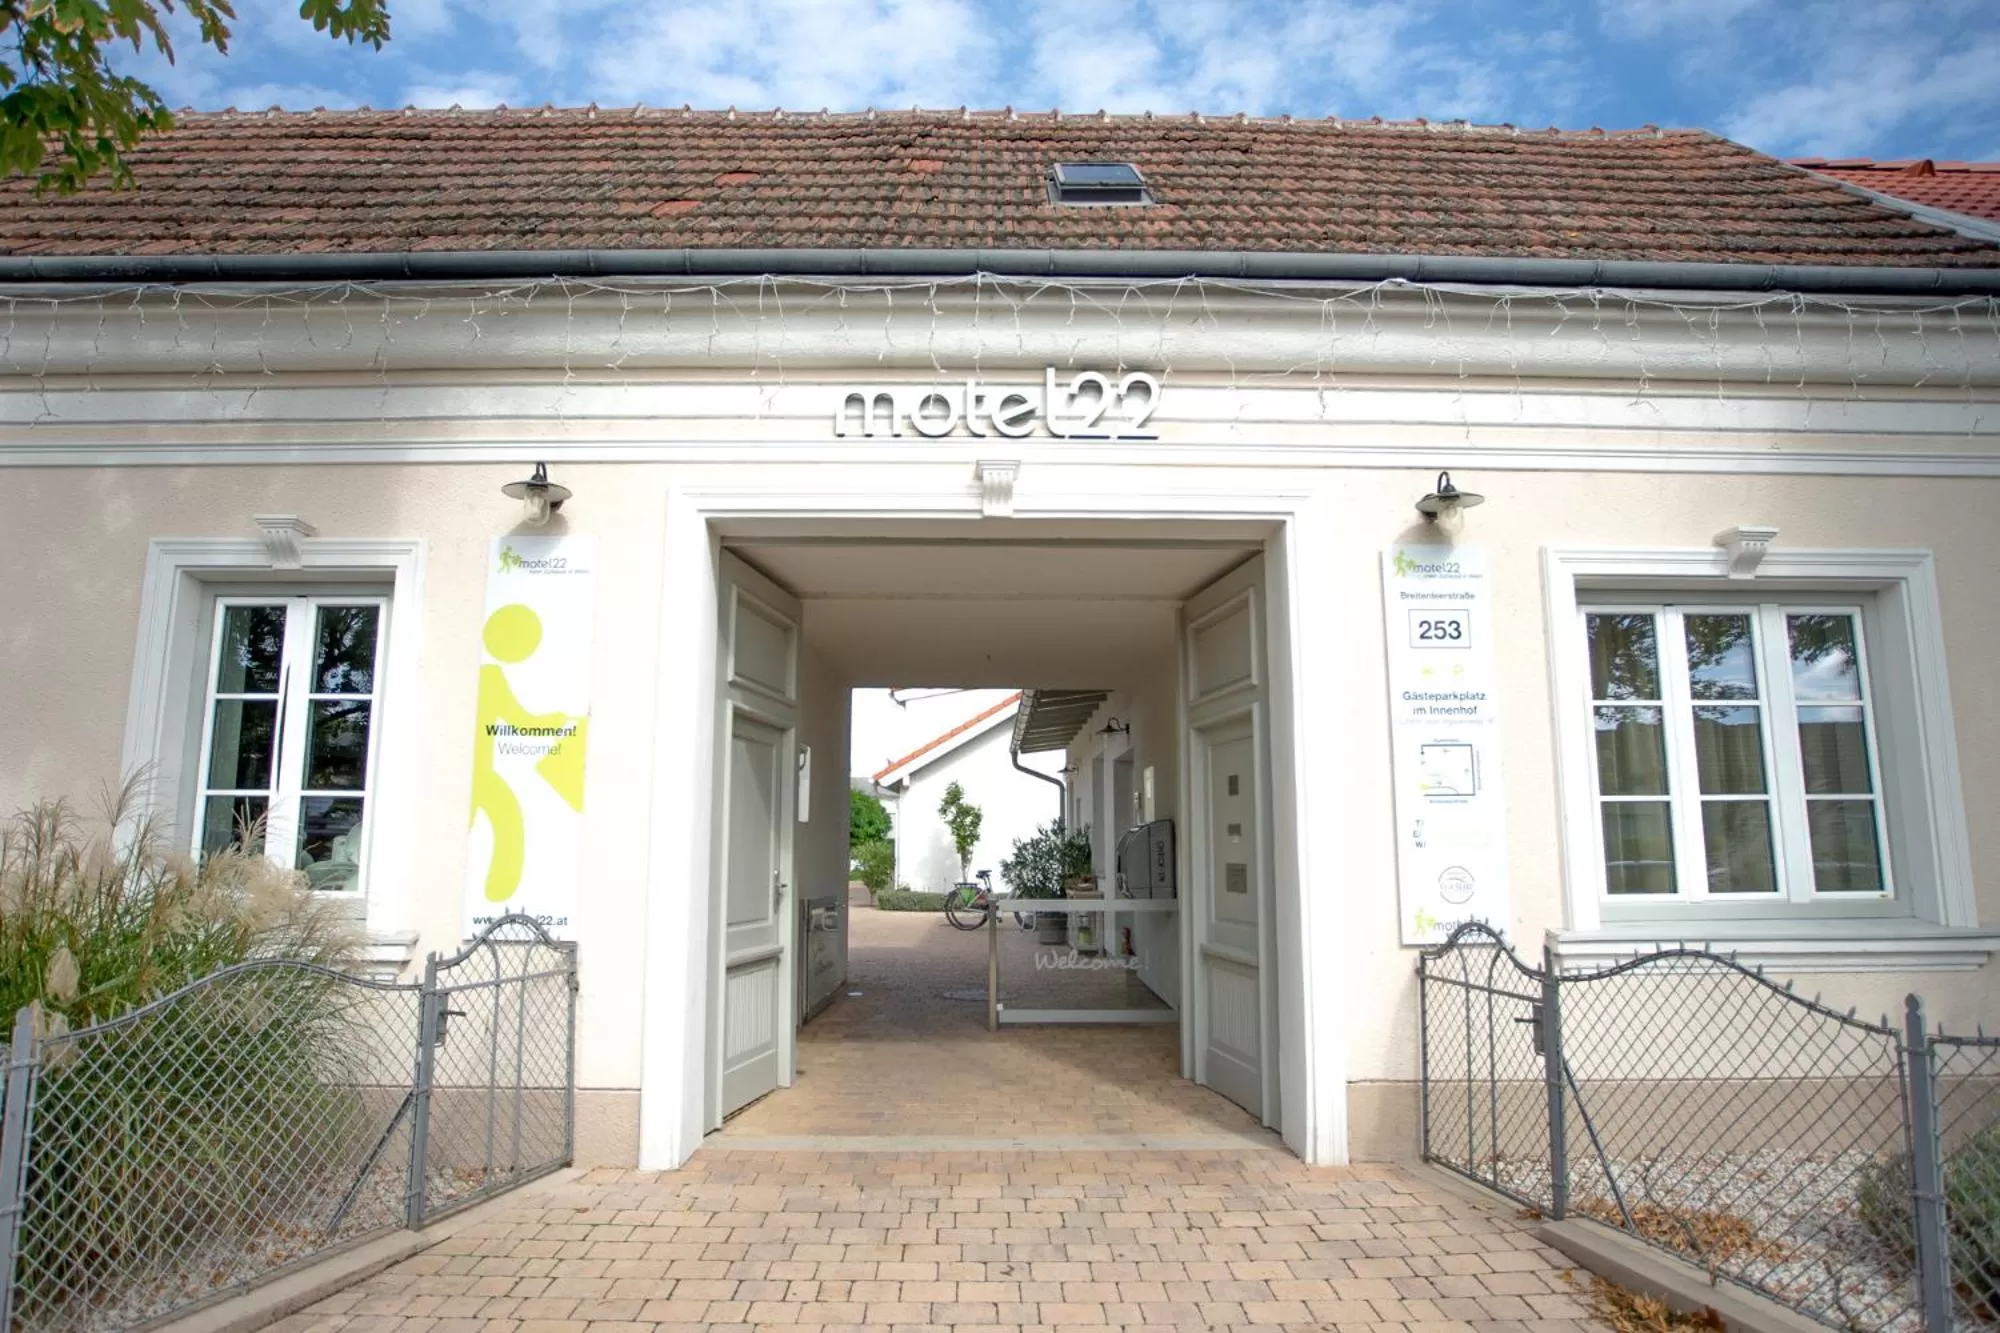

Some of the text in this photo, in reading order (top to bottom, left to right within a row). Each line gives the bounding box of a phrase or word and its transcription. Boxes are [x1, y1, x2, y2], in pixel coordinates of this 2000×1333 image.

[834, 367, 1159, 439] motel22
[1418, 620, 1462, 640] 253
[1402, 690, 1487, 702] Gästeparkplatz
[1412, 705, 1478, 715] im Innenhof
[485, 724, 577, 737] Willkommen!
[498, 742, 562, 755] Welcome!
[1034, 948, 1150, 972] Welcome!
